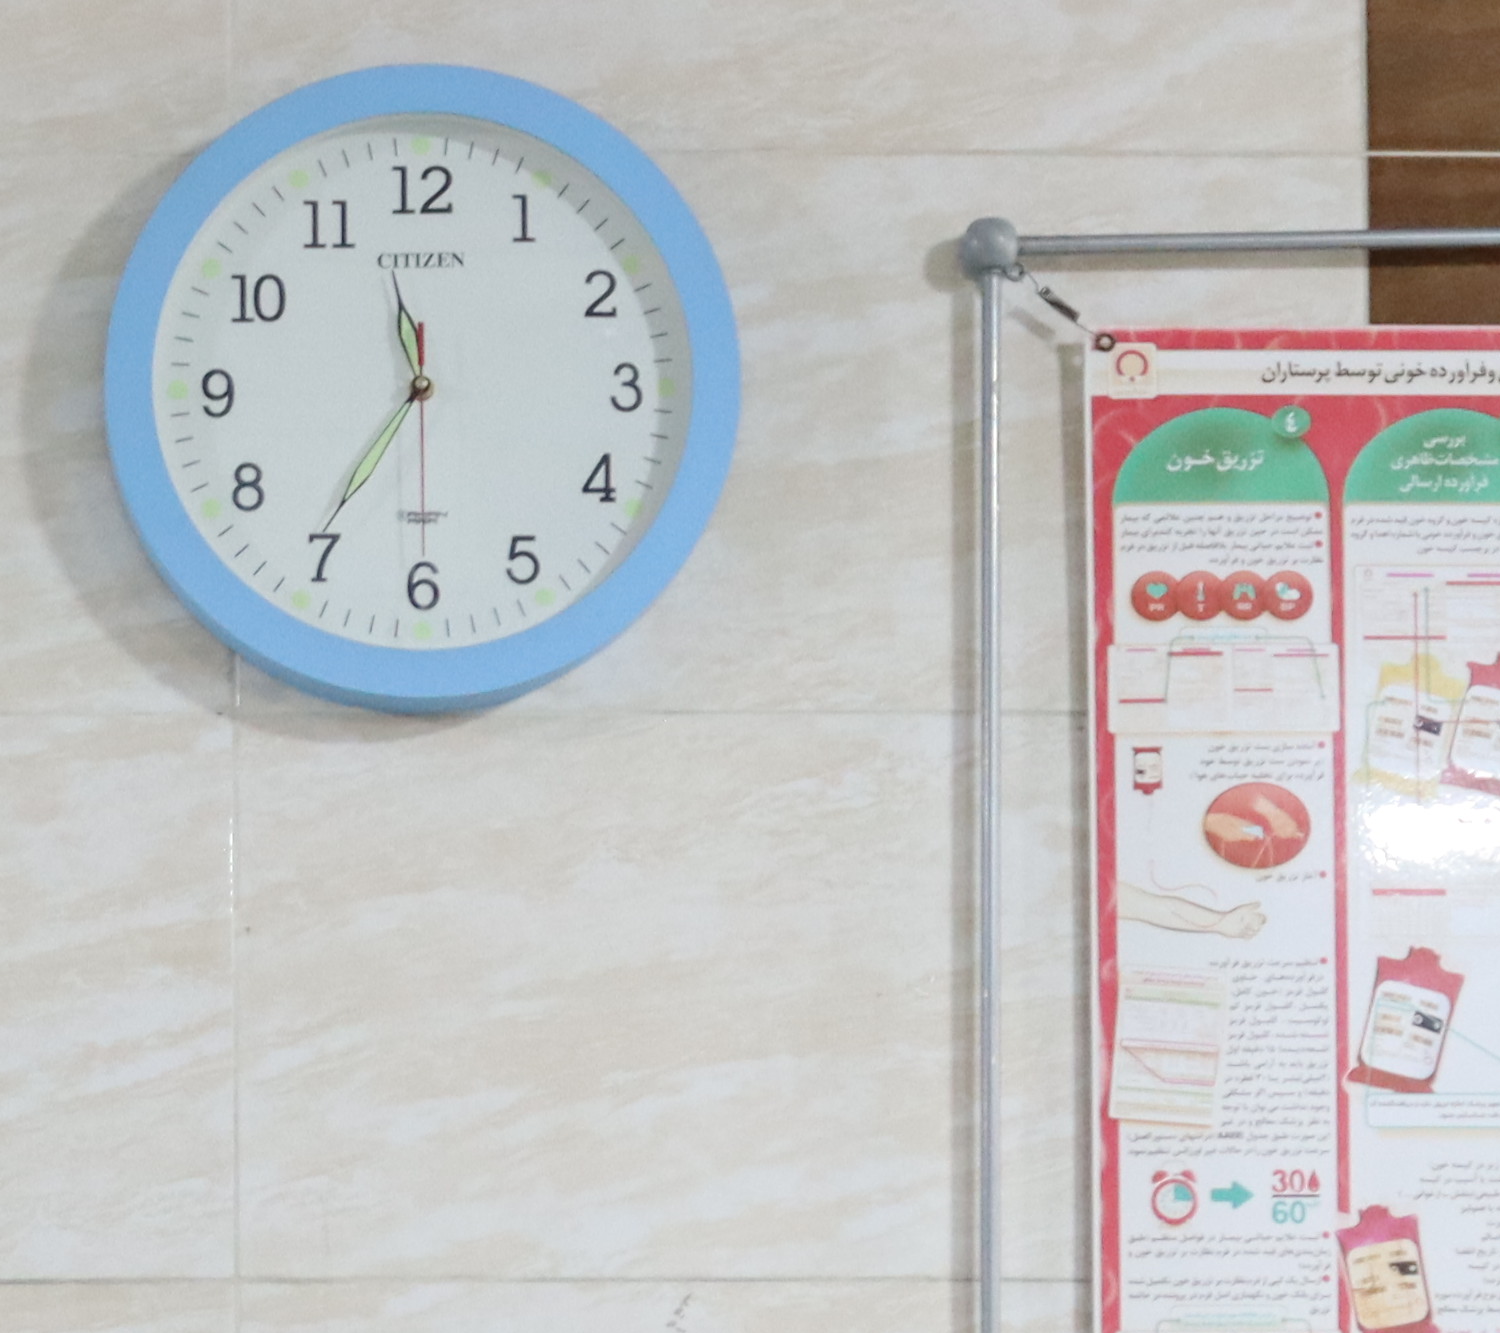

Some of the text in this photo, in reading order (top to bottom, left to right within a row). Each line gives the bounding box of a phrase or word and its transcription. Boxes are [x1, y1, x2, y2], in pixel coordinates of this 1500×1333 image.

[391, 166, 454, 214] 12
[303, 200, 356, 248] 11
[511, 195, 537, 243] 1
[376, 252, 465, 269] CITIZEN
[230, 275, 286, 323] 10
[584, 270, 618, 317] 2
[201, 368, 235, 417] 9
[610, 363, 643, 412] 3
[1262, 361, 1329, 385] پرستاران
[1336, 361, 1381, 385] توسط
[1384, 361, 1425, 385] خونی
[582, 453, 617, 502] 4
[1216, 449, 1264, 473] تزریق
[232, 463, 265, 511] 8
[308, 534, 341, 582] 7
[507, 536, 541, 584] 5
[407, 562, 440, 610] 6
[1272, 1168, 1303, 1194] 30
[1272, 1201, 1306, 1224] 60
